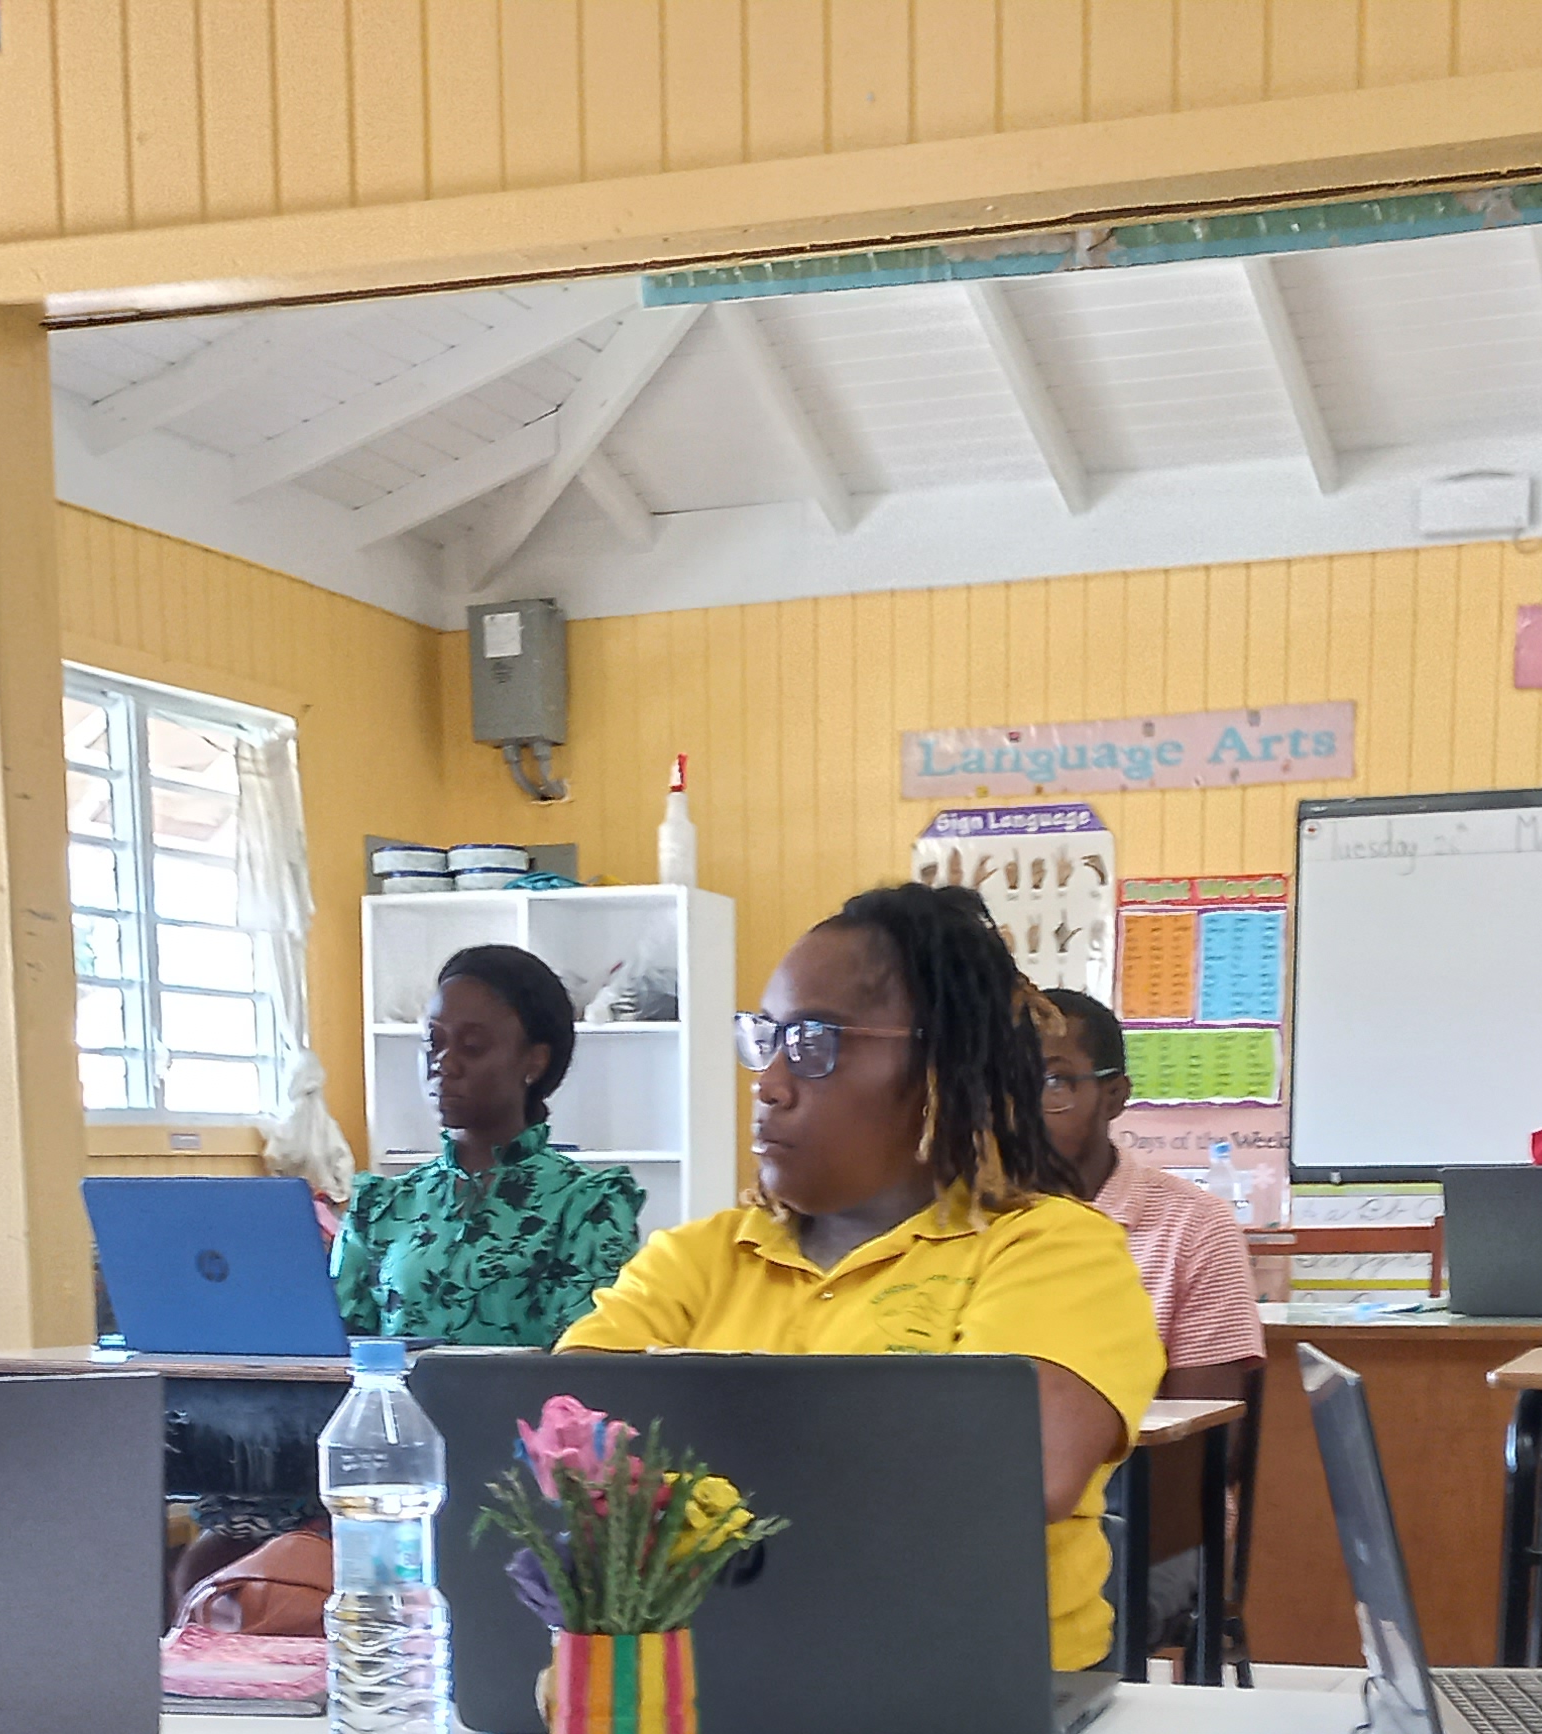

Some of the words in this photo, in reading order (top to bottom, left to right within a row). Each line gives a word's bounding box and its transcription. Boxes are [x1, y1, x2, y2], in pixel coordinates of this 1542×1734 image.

[916, 736, 1185, 782] Language
[1207, 726, 1338, 763] Arts
[935, 812, 984, 835] Sign
[987, 810, 1092, 832] Language
[1197, 876, 1285, 899] Words
[1119, 1130, 1167, 1154] Days
[1170, 1130, 1194, 1150] of
